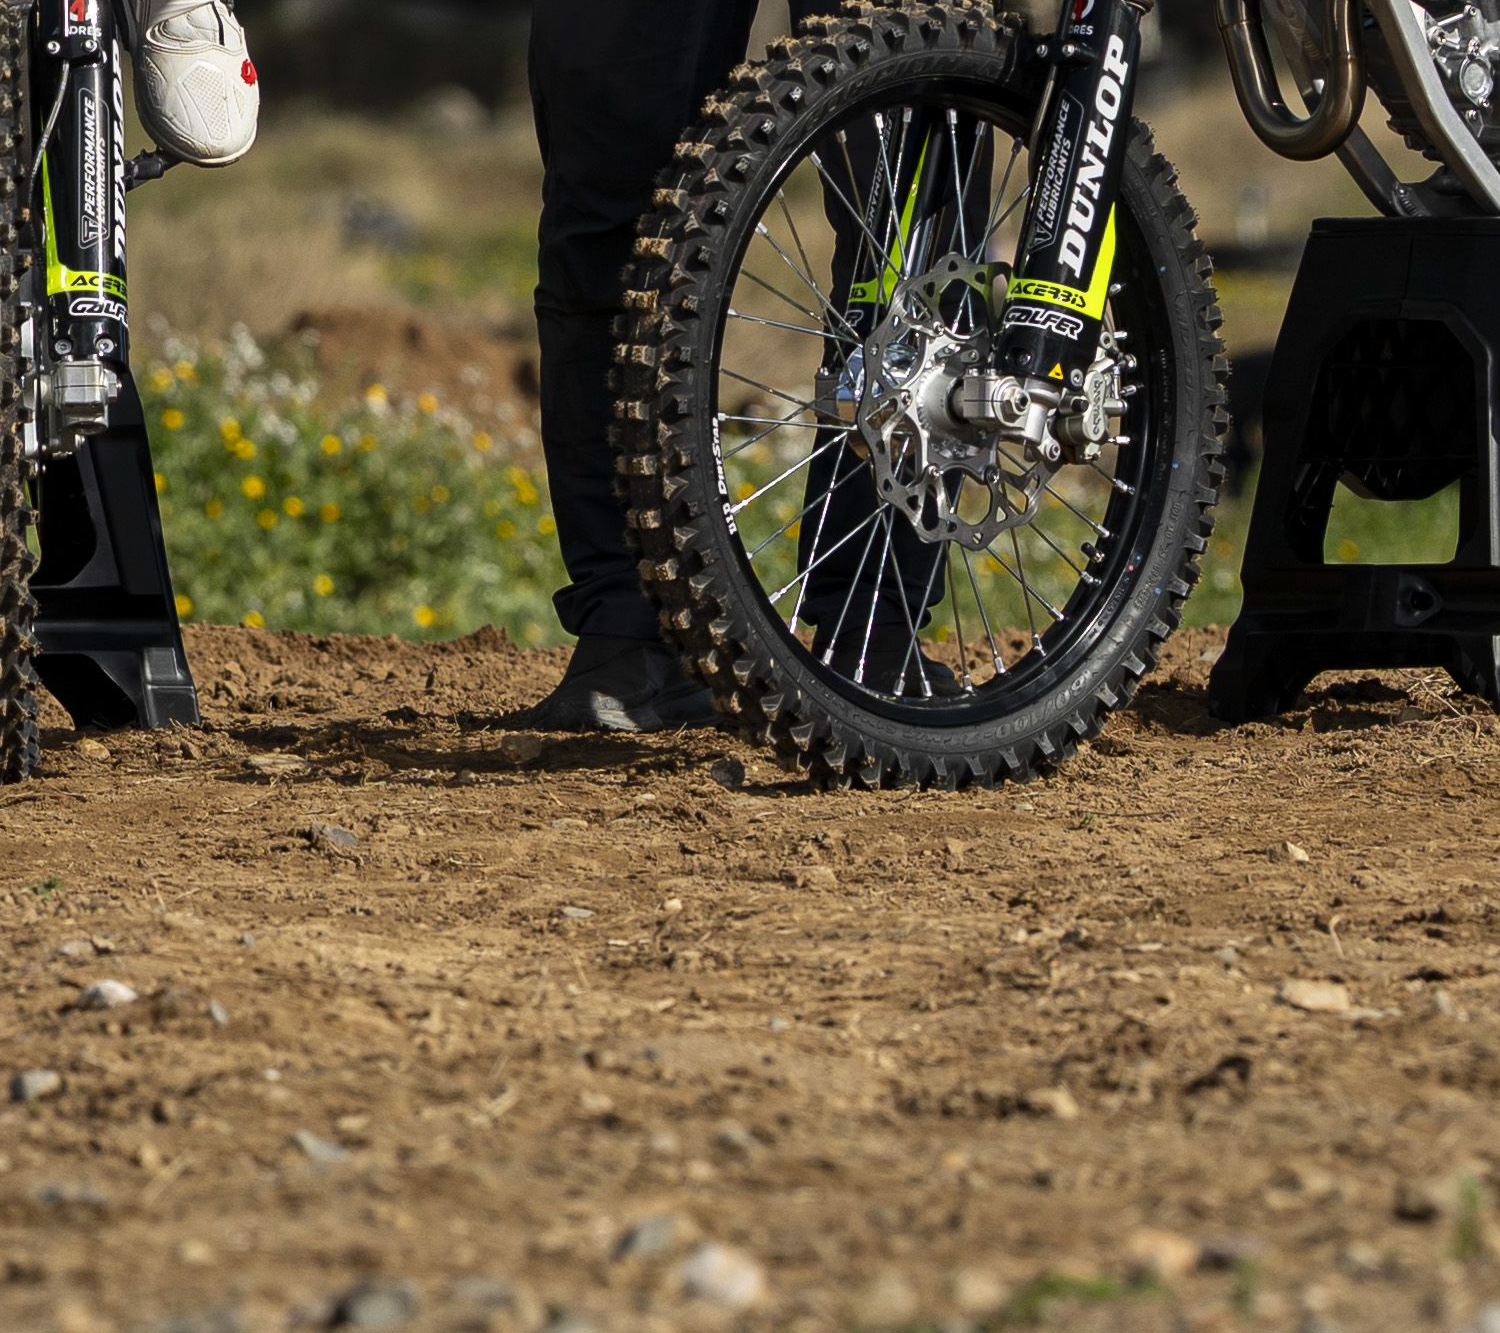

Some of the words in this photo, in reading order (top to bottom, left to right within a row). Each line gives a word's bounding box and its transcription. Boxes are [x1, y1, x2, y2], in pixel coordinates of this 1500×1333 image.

[84, 96, 95, 216] PERFORMANCE
[1036, 99, 1070, 222] PERFORMANCE
[1046, 138, 1071, 230] LUBRICANTS
[1058, 34, 1128, 279] DUNLOP
[1004, 305, 1083, 340] GALFER
[1010, 282, 1087, 309] ACERBIS
